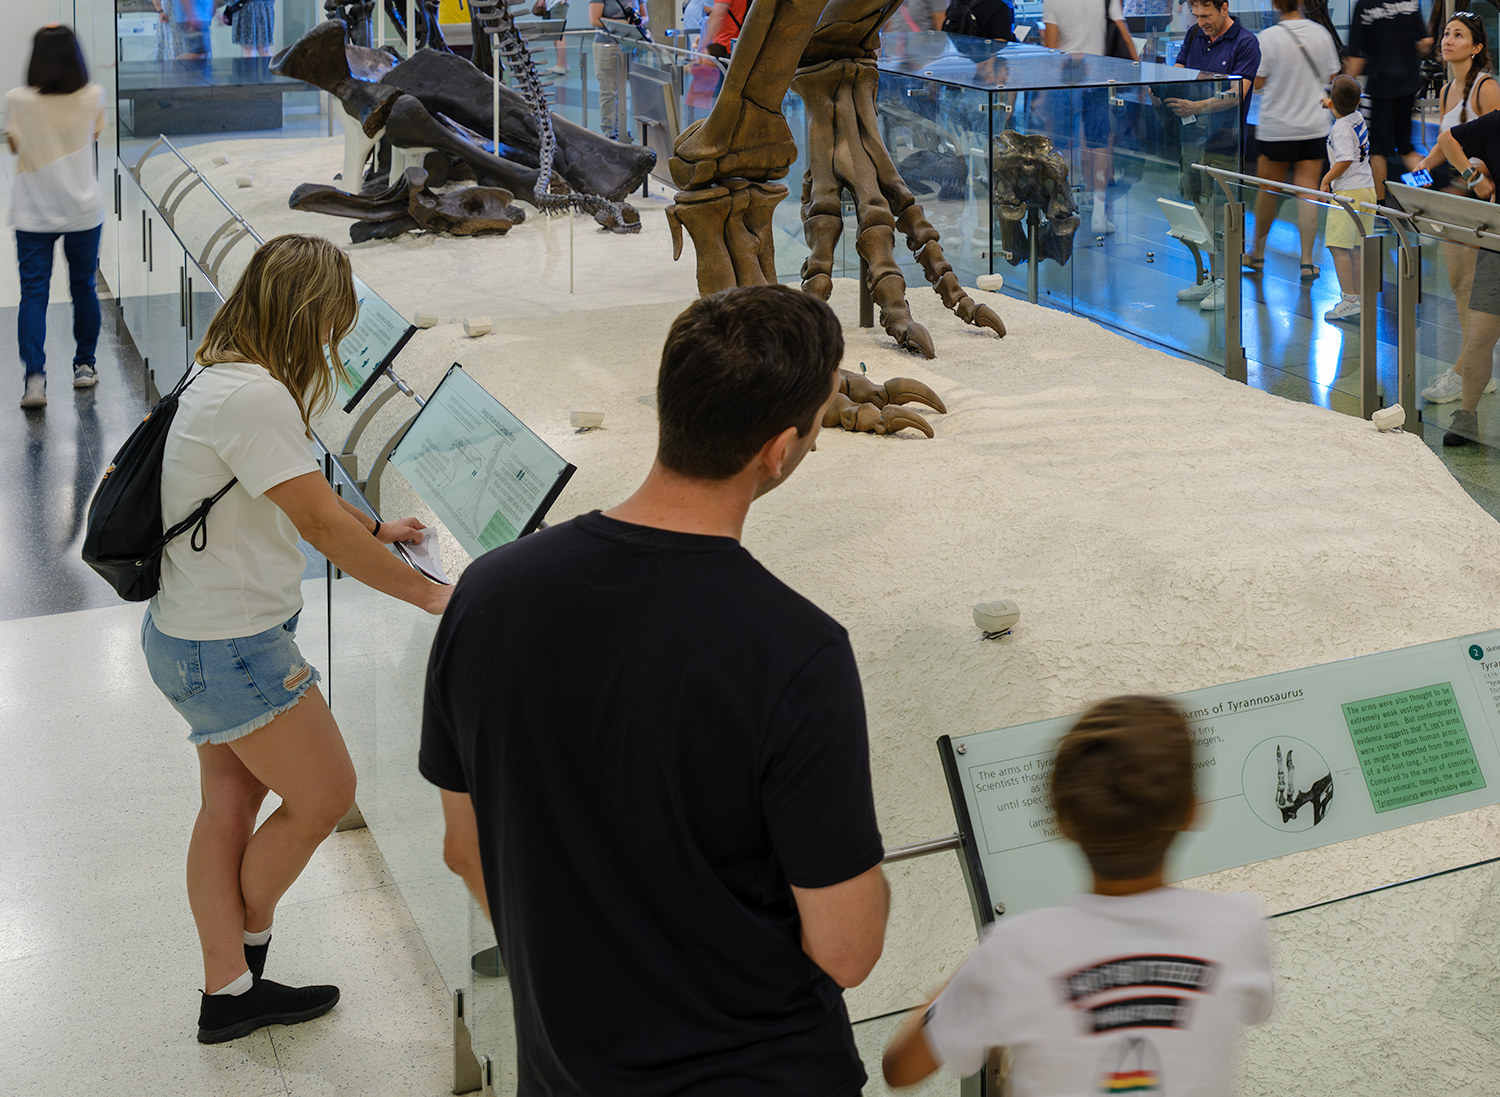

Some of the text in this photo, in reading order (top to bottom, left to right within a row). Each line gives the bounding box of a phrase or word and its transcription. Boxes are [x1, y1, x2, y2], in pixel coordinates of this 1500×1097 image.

[1212, 703, 1223, 714] of
[1227, 689, 1303, 712] Tyrannosaurus
[1350, 713, 1380, 725] extremely
[1382, 709, 1398, 718] weak
[1400, 704, 1425, 714] vestiges
[1435, 698, 1452, 706] larger
[1361, 704, 1377, 712] arms
[1379, 700, 1393, 708] were
[1395, 697, 1408, 705] also
[1409, 691, 1433, 701] thought
[1354, 709, 1456, 735] ancestral arms. But contemporary
[1357, 735, 1382, 745] evidence
[1384, 729, 1409, 739] suggests
[1410, 725, 1422, 733] that
[1430, 720, 1444, 730] rex's
[1445, 718, 1460, 726] arms
[978, 771, 996, 780] The
[999, 766, 1021, 776] arms
[1023, 761, 1033, 771] of
[1198, 726, 1216, 737] tiny.
[1360, 729, 1457, 755] were stronger than human arms
[1373, 754, 1391, 763] might
[1401, 745, 1427, 757] expected
[1428, 743, 1443, 751] from
[1370, 774, 1401, 786] Compared
[1422, 766, 1437, 774] arms
[1448, 757, 1474, 769] similarly
[1383, 759, 1422, 772] 40-foot-long,
[1423, 755, 1439, 763] 5-ton
[1441, 749, 1470, 759] carnivore.
[976, 778, 1019, 793] Scientists
[1022, 769, 1054, 783] though
[997, 757, 1216, 812] until specim owed
[1031, 782, 1052, 793] as th
[1374, 787, 1390, 797] sized
[1393, 782, 1418, 792] animals,
[1419, 776, 1442, 786] though,
[1455, 770, 1470, 778] arms
[1376, 793, 1419, 808] Tyrannosaurus
[1434, 783, 1458, 795] probably
[1459, 779, 1475, 788] weak.
[1029, 815, 1059, 829] (amon
